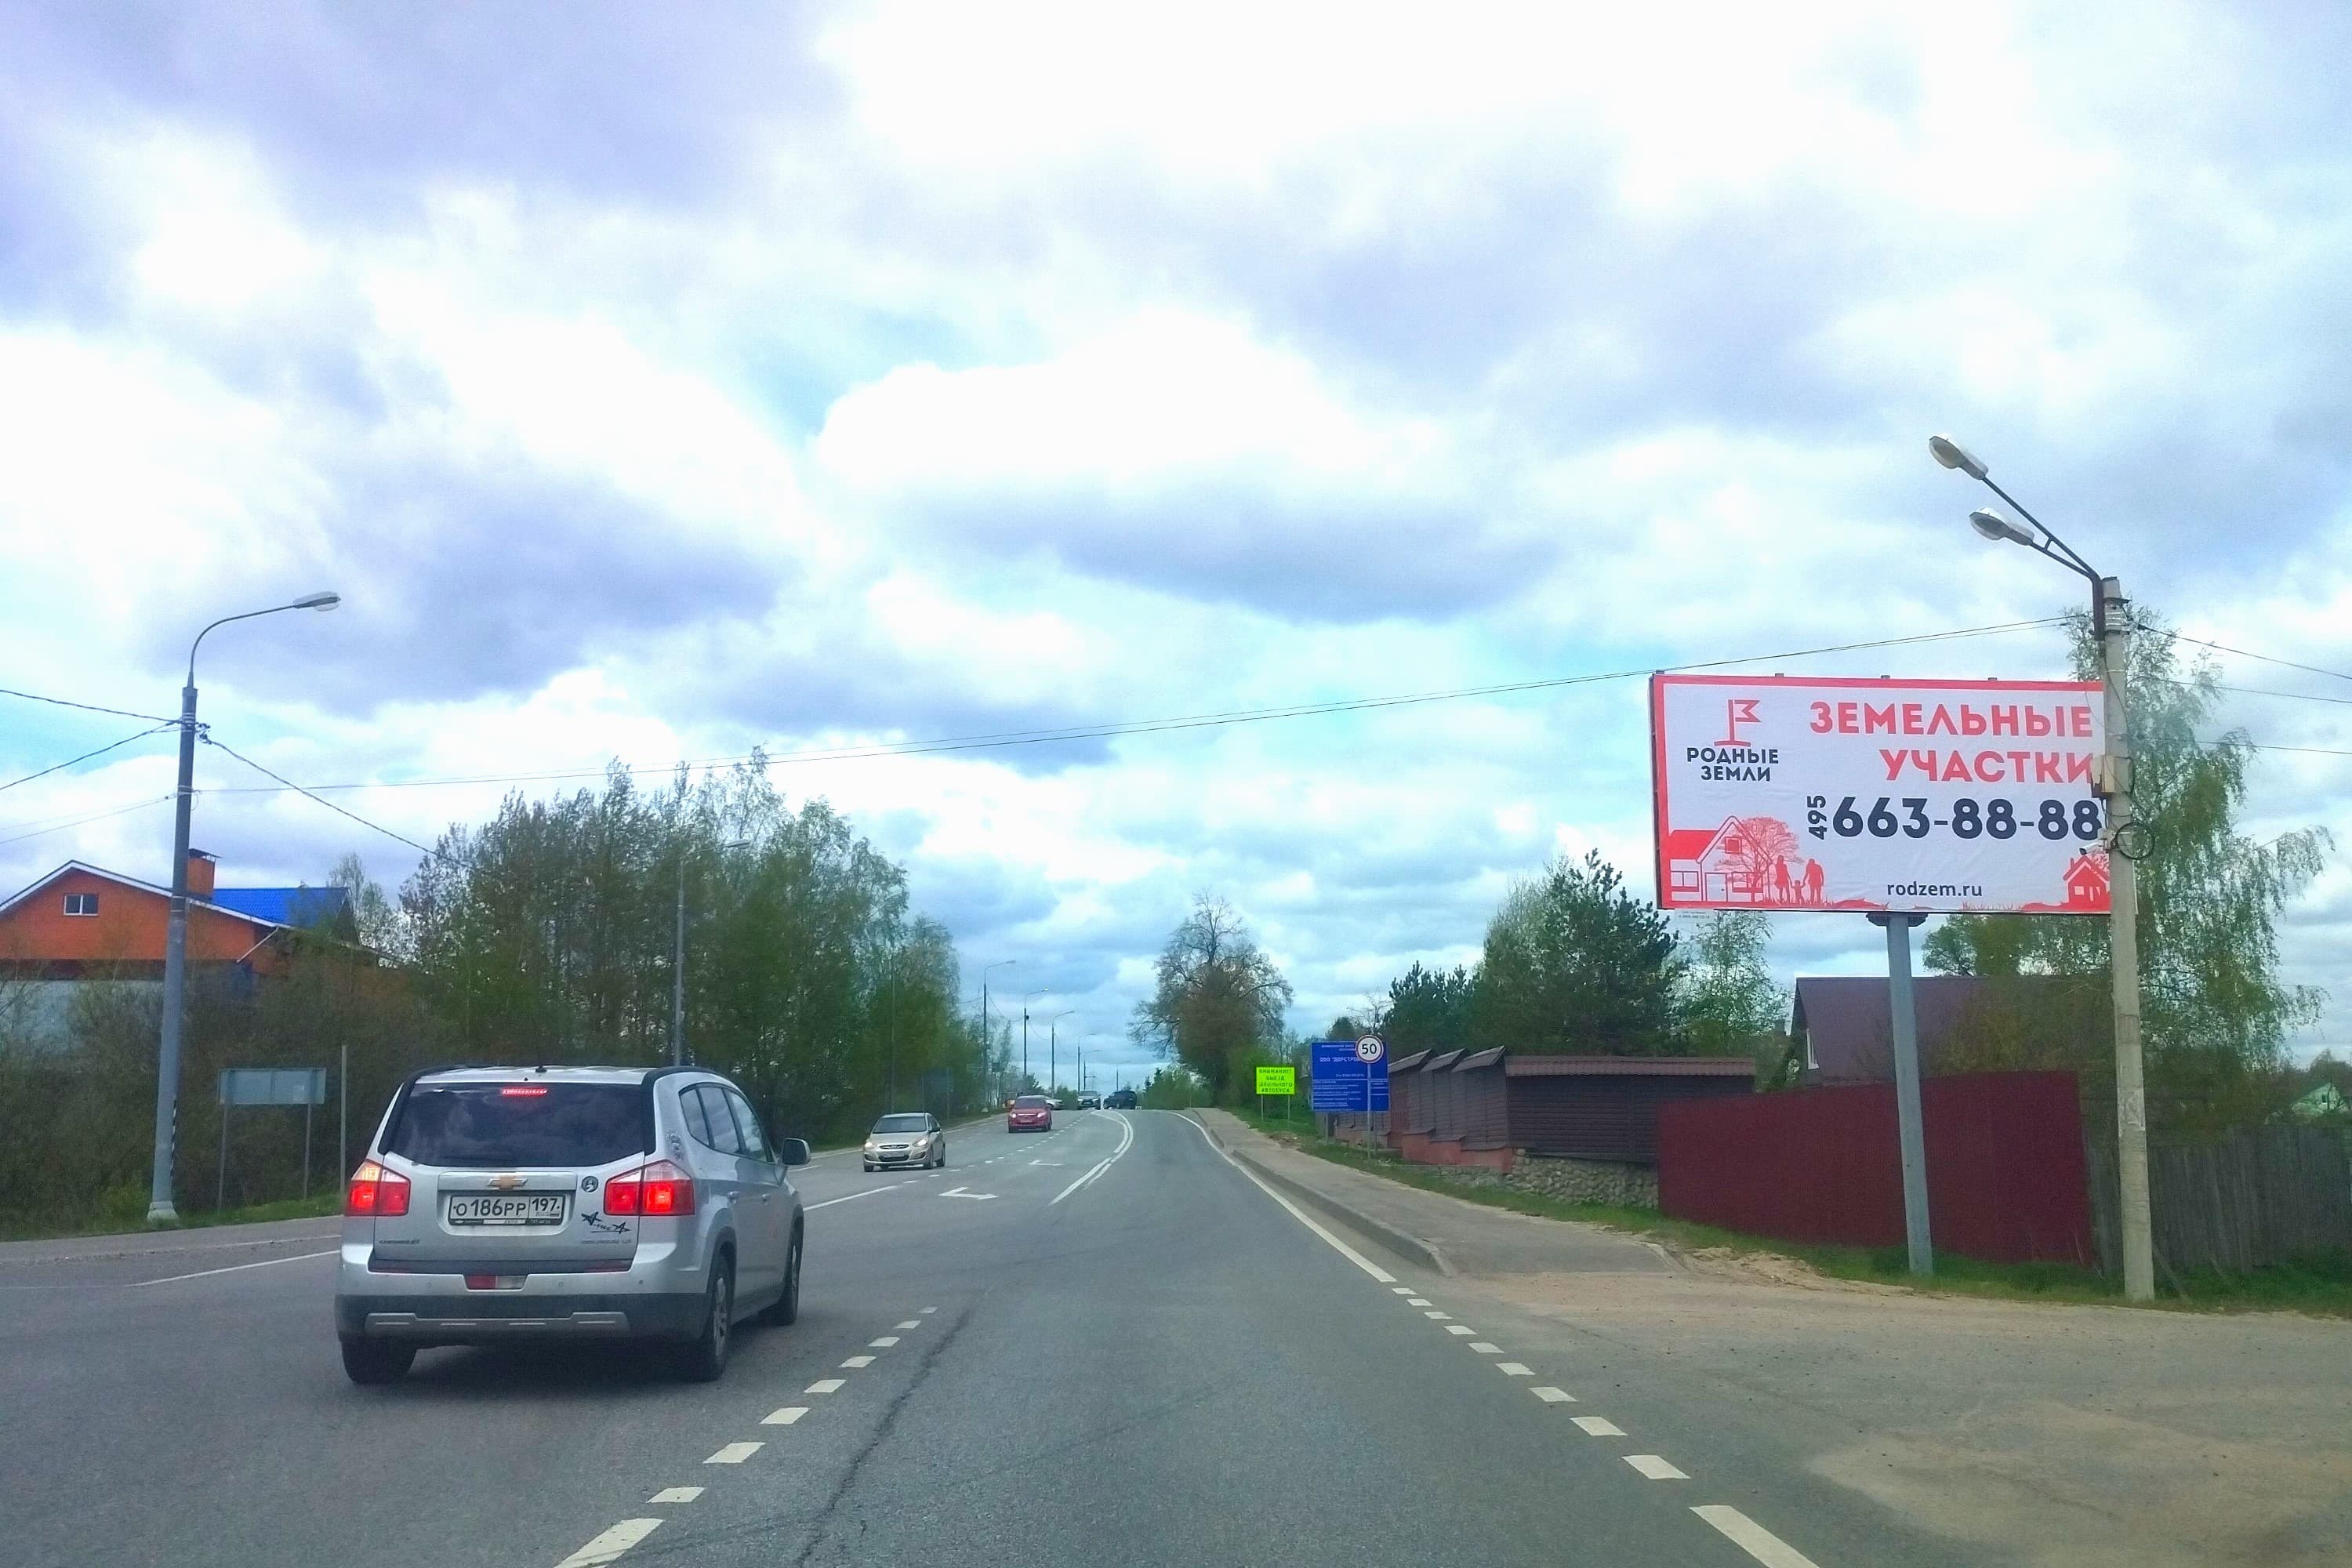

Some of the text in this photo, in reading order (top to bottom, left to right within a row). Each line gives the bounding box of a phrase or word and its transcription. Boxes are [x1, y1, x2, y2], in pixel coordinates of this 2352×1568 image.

[1809, 701, 2093, 737] ЗЕМЕЛЬНЫЕ
[1686, 747, 1779, 764] РОДНЫЕ
[1700, 765, 1771, 782] ЗЕМЛИ
[1878, 749, 2094, 784] УЧАСТКИ
[1807, 795, 1828, 840] 495
[1832, 796, 2103, 840] 663-88-88
[1886, 880, 1983, 897] rodzem.ru
[1362, 1044, 1377, 1054] 50
[532, 1198, 558, 1211] 197
